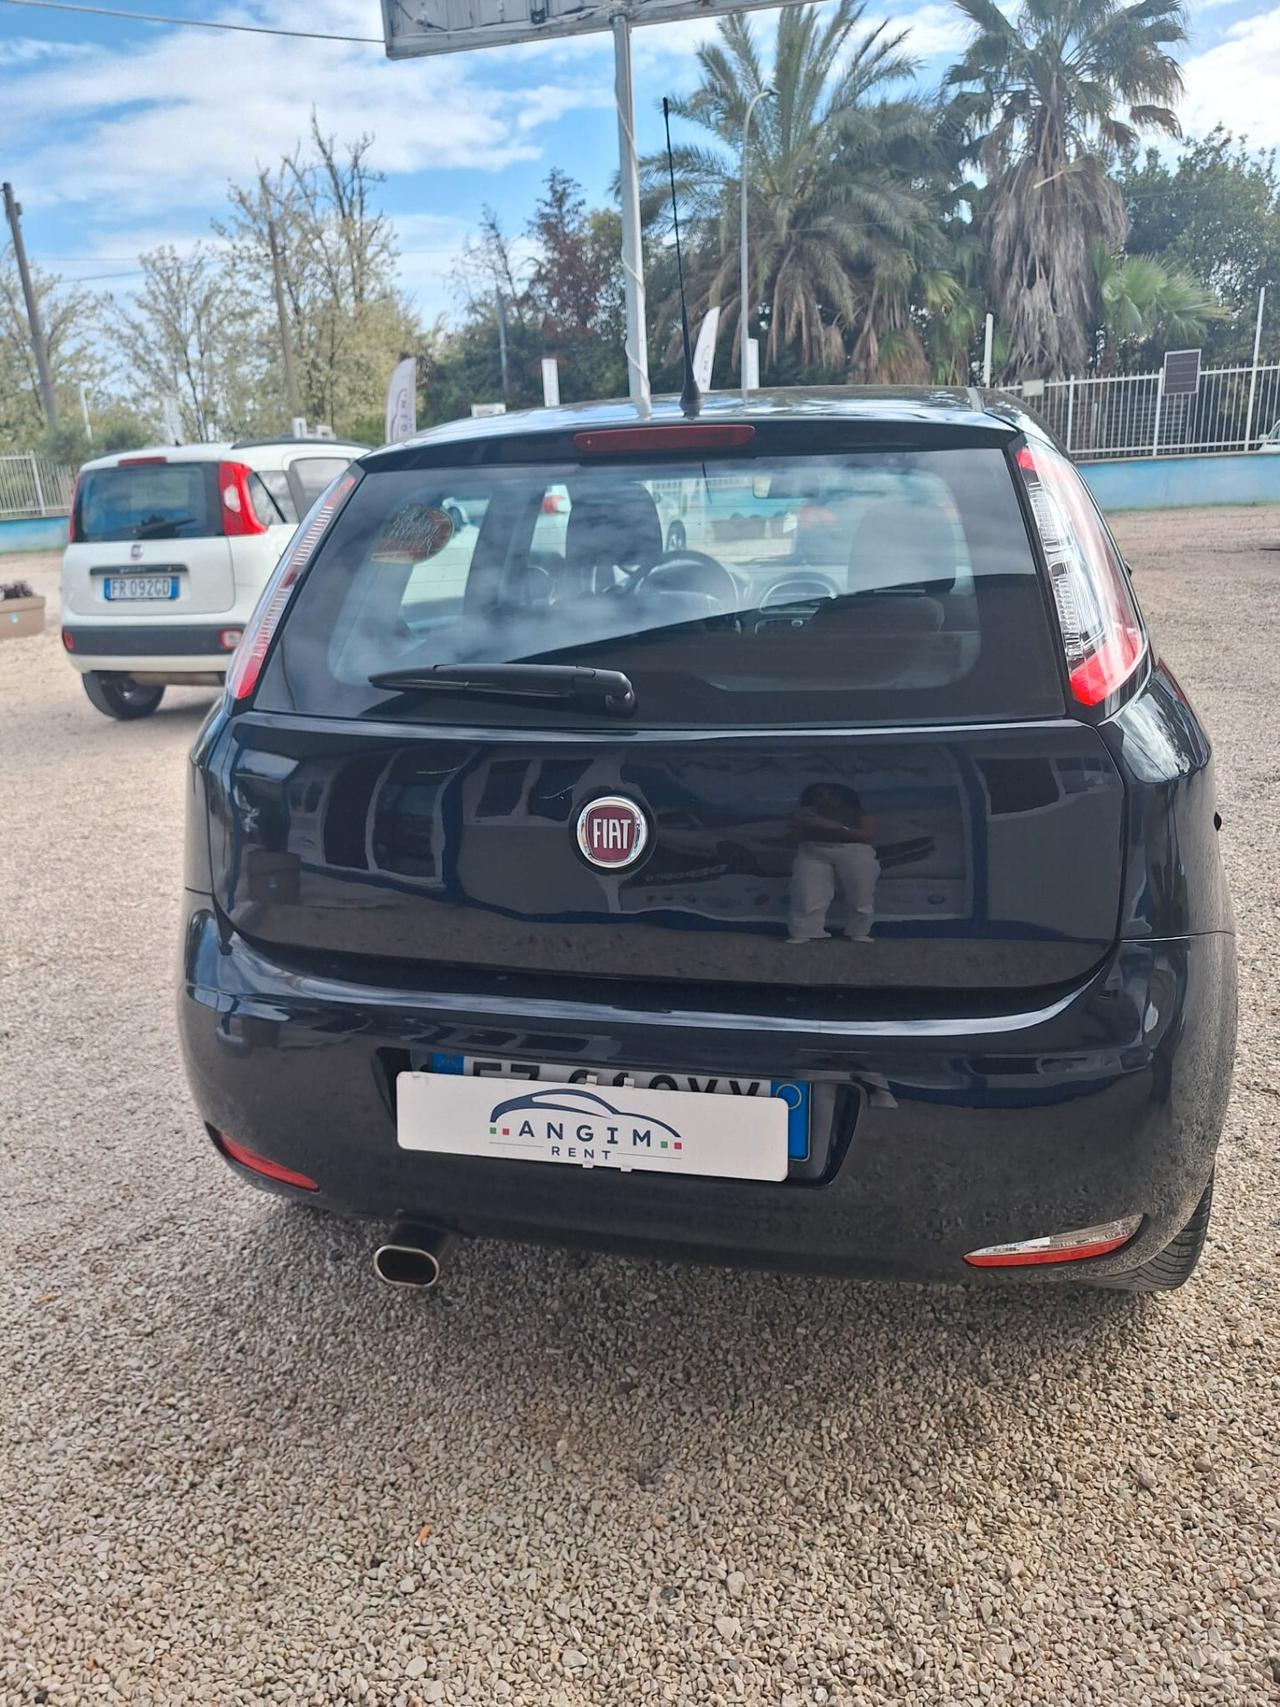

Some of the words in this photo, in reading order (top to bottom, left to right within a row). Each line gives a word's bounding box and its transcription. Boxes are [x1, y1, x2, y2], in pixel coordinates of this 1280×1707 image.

[112, 580, 126, 597] FR
[593, 818, 632, 850] FIAT
[518, 1120, 652, 1148] ANGIM
[551, 1145, 612, 1161] RENT
